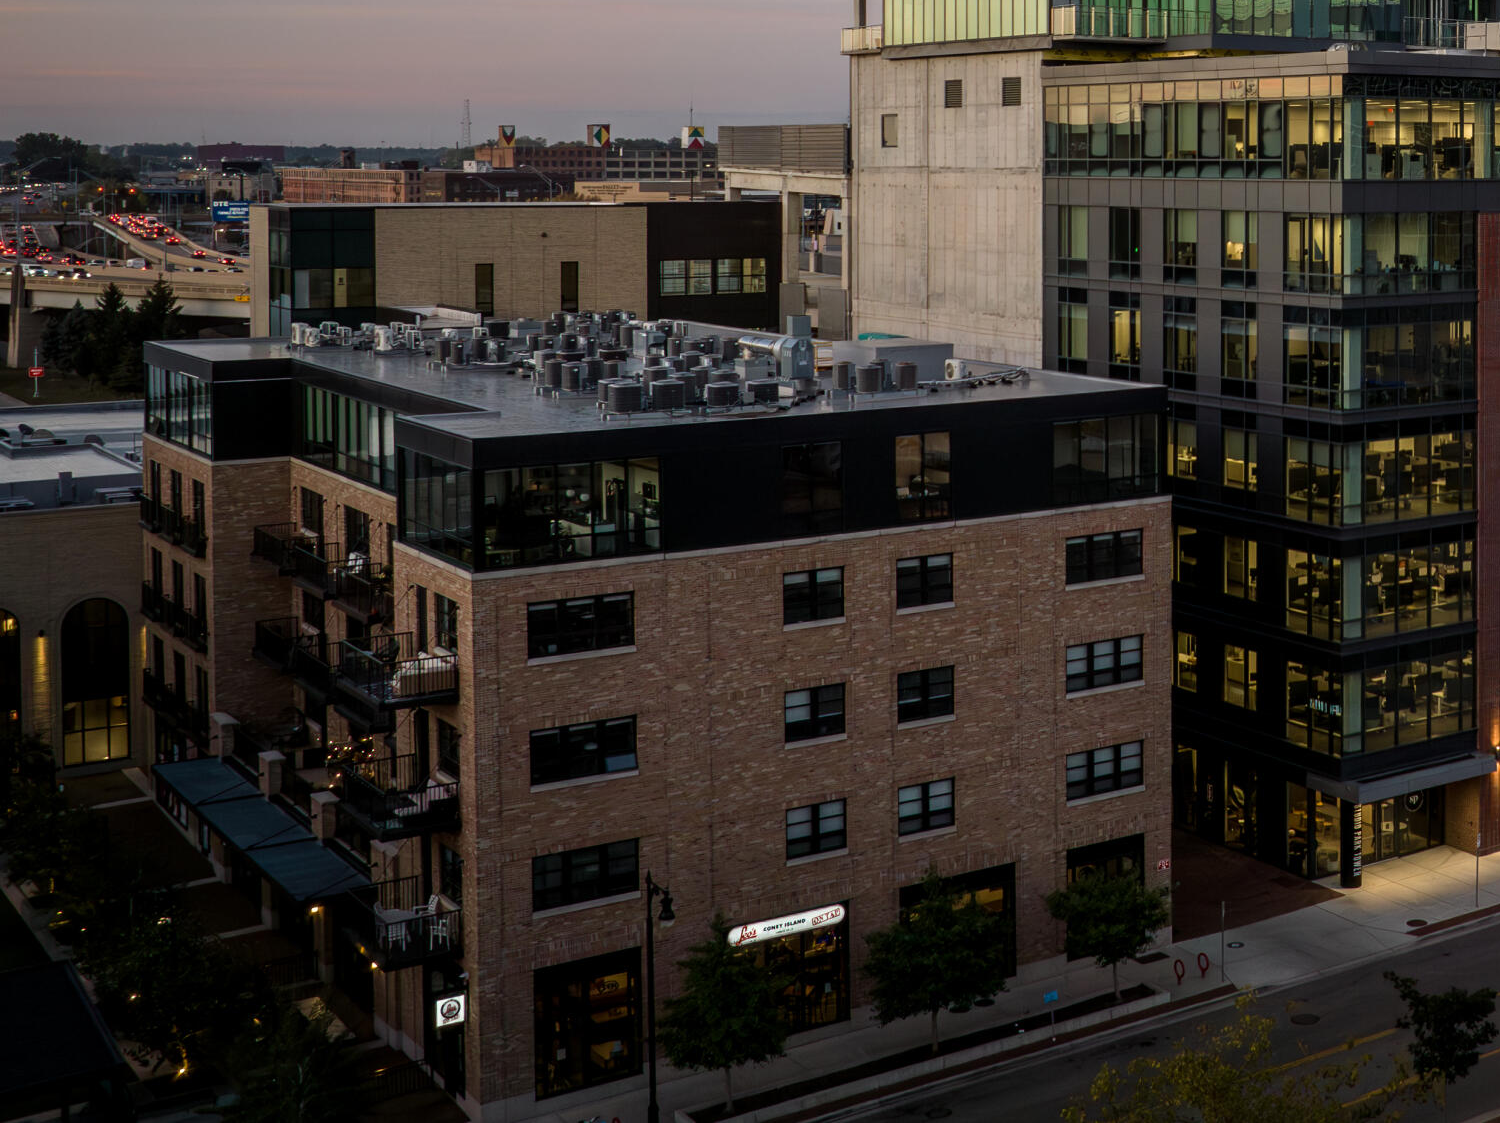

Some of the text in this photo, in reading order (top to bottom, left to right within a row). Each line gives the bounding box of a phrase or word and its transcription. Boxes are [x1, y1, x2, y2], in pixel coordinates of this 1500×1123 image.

[1353, 830, 1362, 851] PARK
[1352, 852, 1362, 877] TOWER
[735, 925, 758, 946] Leo's
[763, 924, 783, 932] CONEY
[784, 918, 806, 927] ISLAND
